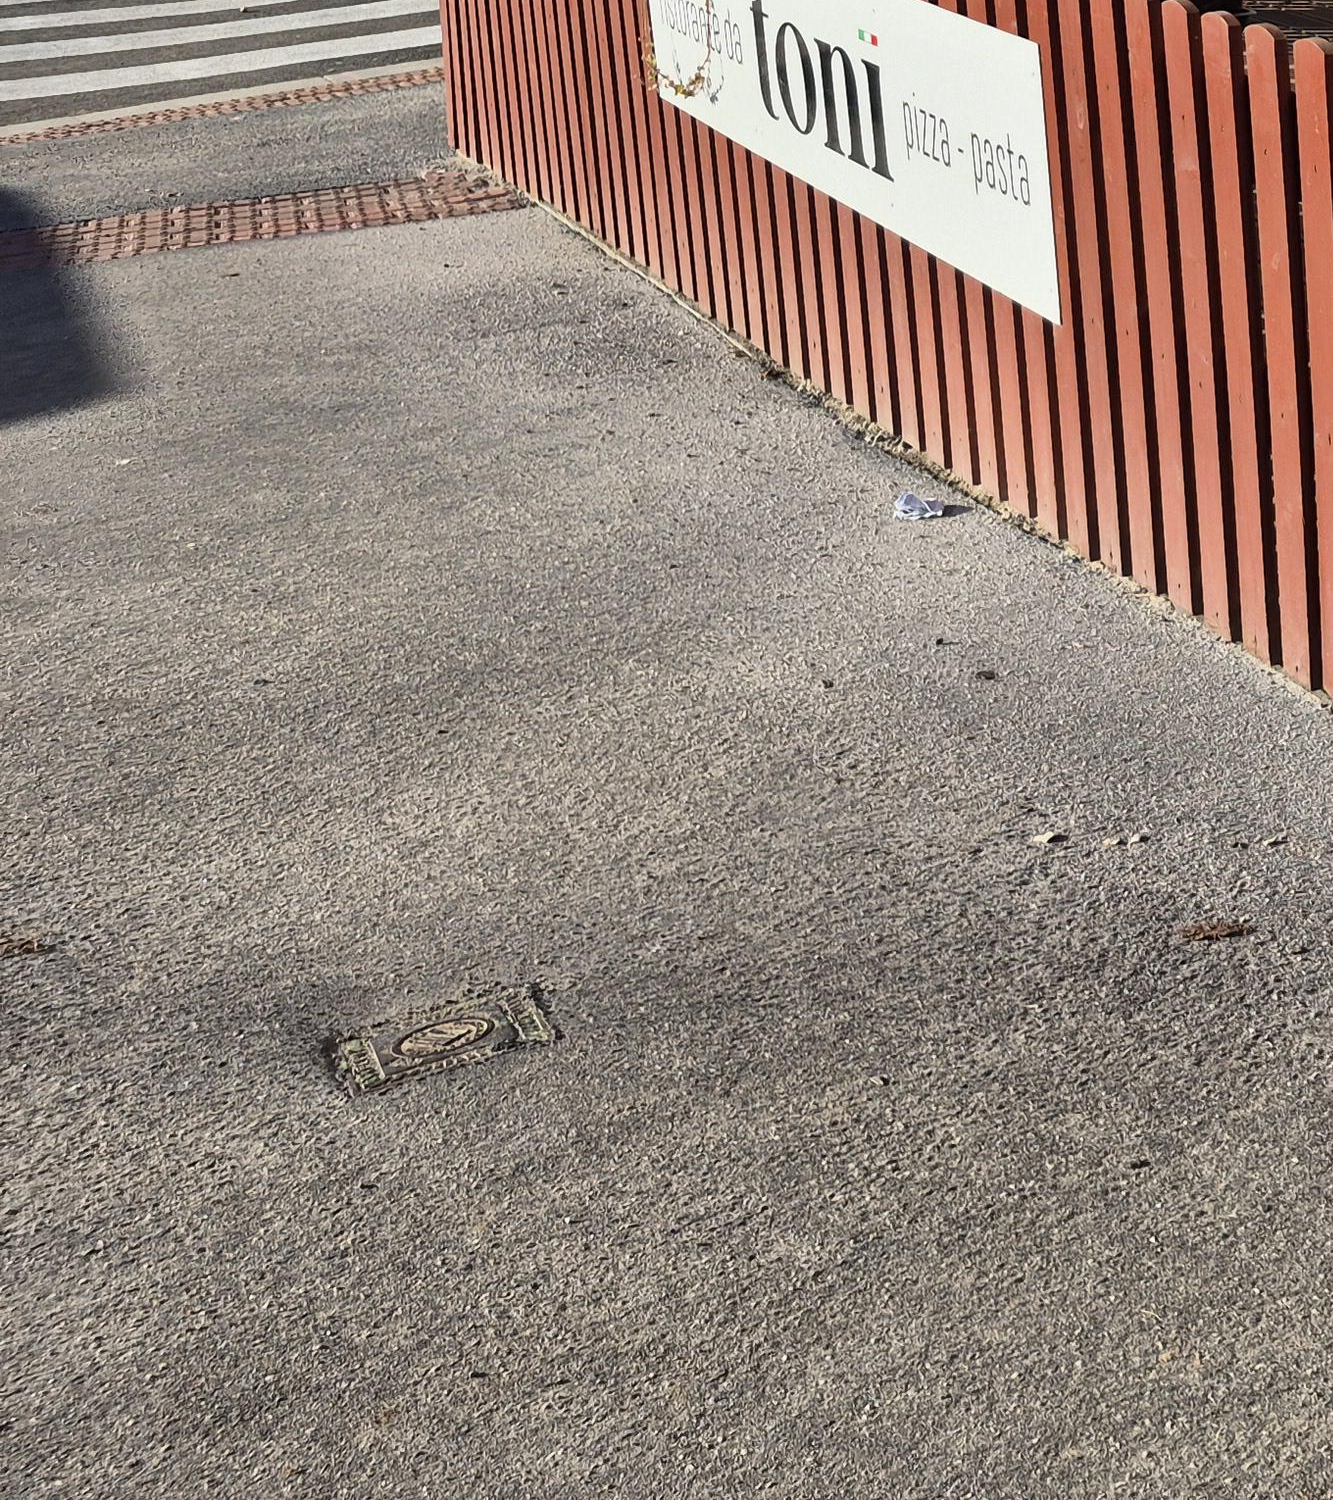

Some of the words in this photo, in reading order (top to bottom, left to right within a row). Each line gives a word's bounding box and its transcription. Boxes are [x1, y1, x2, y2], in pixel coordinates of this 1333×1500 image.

[724, 9, 743, 66] da
[902, 92, 952, 169] pizza
[970, 130, 1031, 207] pasta
